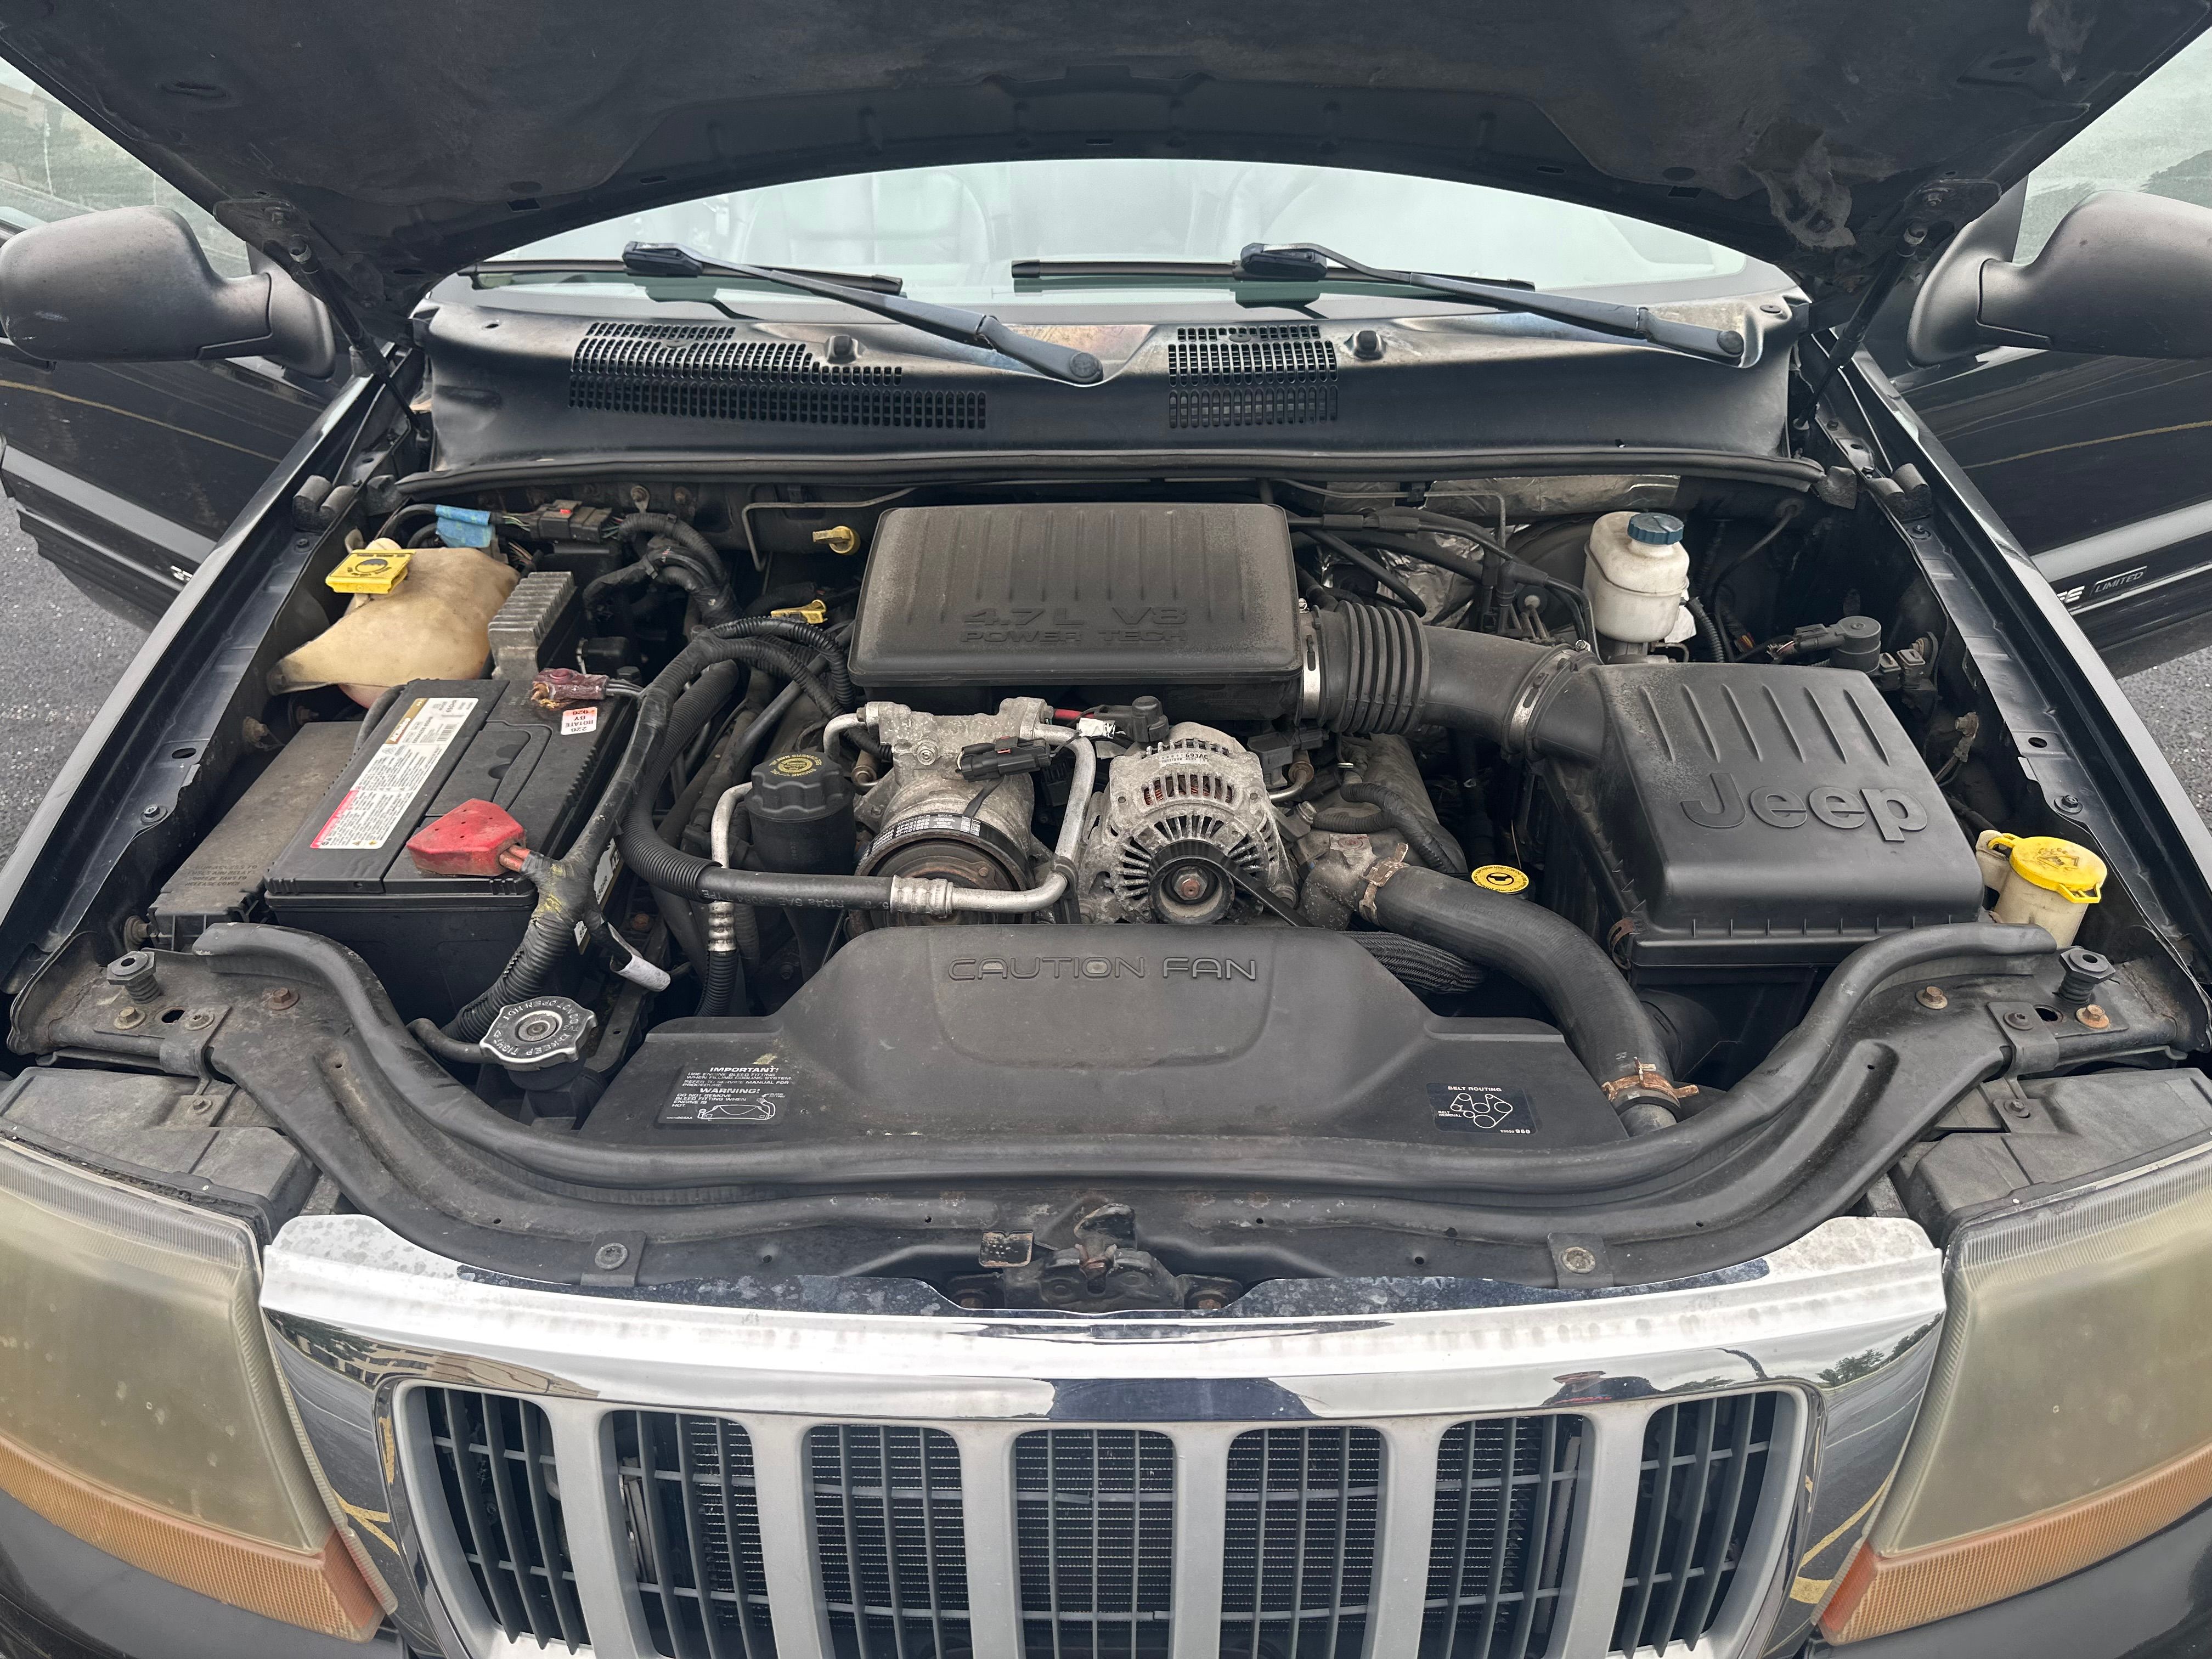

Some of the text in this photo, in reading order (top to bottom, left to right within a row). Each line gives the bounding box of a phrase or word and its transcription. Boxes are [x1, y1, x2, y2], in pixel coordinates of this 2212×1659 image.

[2095, 572, 2144, 594] LIMITED
[1111, 607, 1187, 625] V8
[961, 630, 1188, 643] POWER TECH
[1680, 772, 1928, 842] Jeep
[949, 957, 1257, 981] CAUTION FAN
[526, 1040, 560, 1056] KEEP
